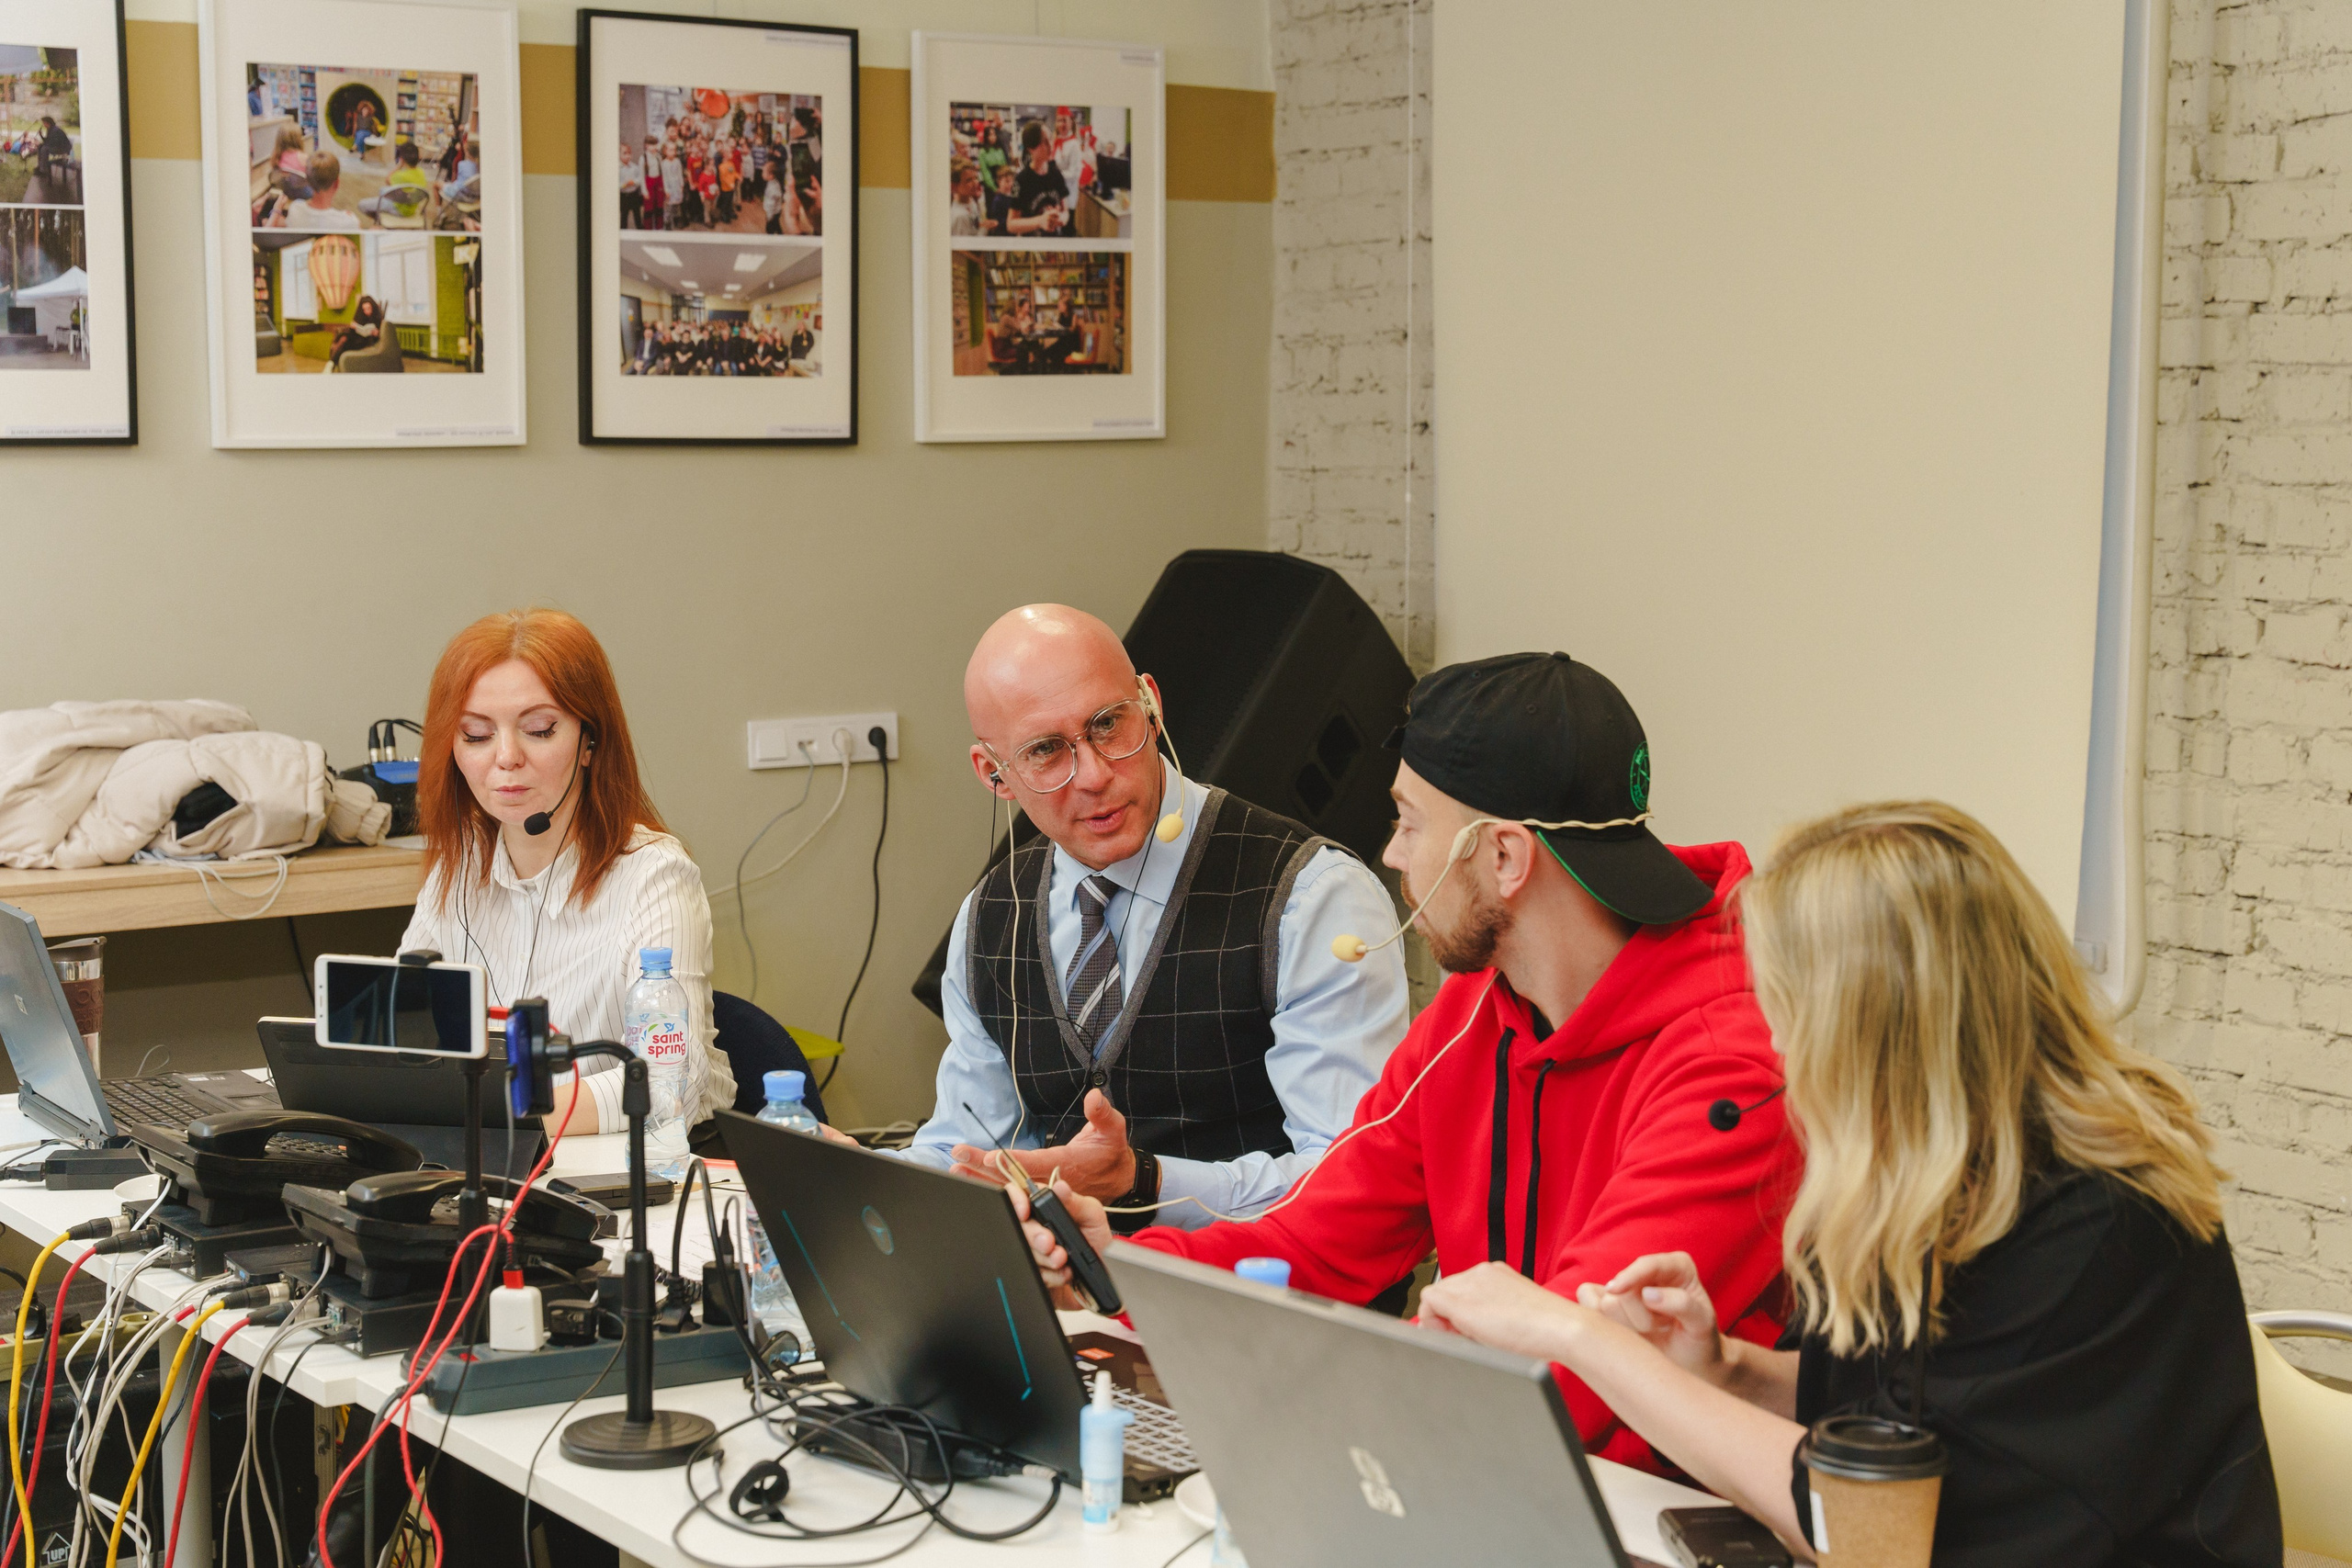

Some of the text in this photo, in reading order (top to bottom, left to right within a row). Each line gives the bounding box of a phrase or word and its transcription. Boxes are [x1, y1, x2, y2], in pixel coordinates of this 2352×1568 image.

[652, 1031, 684, 1043] saint
[648, 1043, 686, 1058] spring
[51, 1548, 65, 1561] UP
